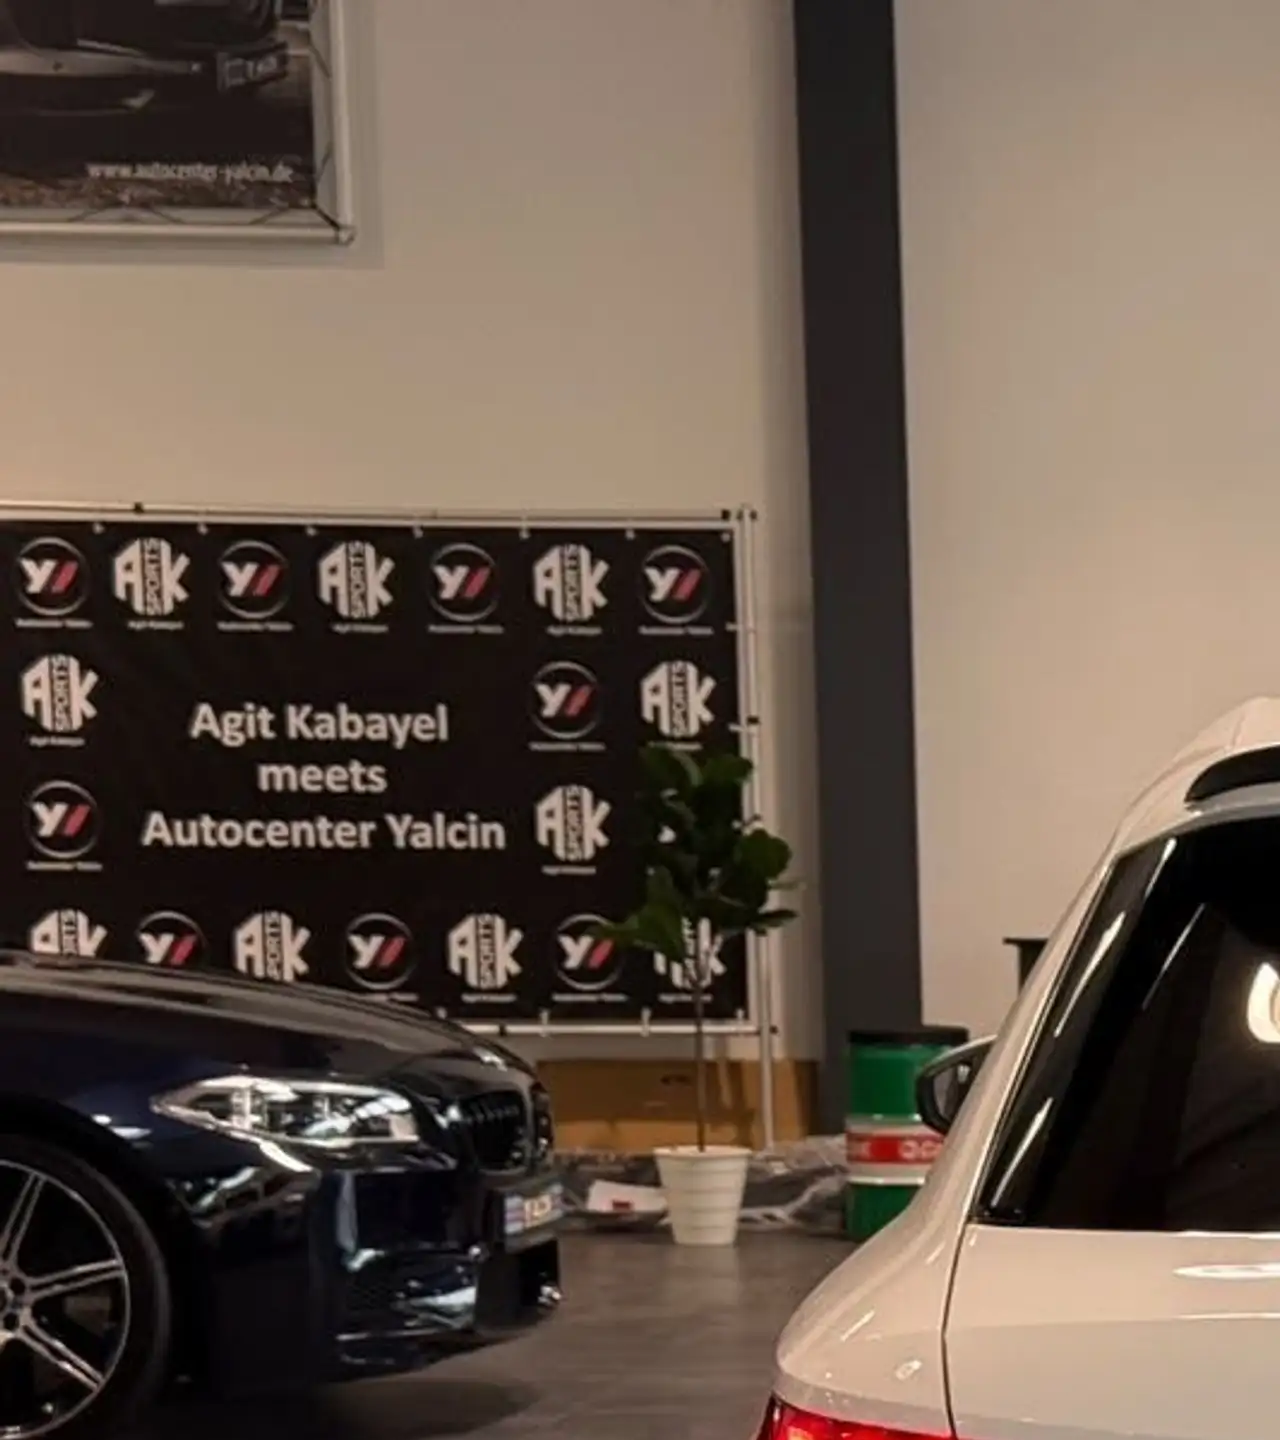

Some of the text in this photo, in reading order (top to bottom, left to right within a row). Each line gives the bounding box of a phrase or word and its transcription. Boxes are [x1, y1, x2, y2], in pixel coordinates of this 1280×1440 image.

[190, 702, 448, 749] Agit Kabayel
[258, 761, 388, 793] meets
[141, 812, 506, 849] Autocenter Yalcin
